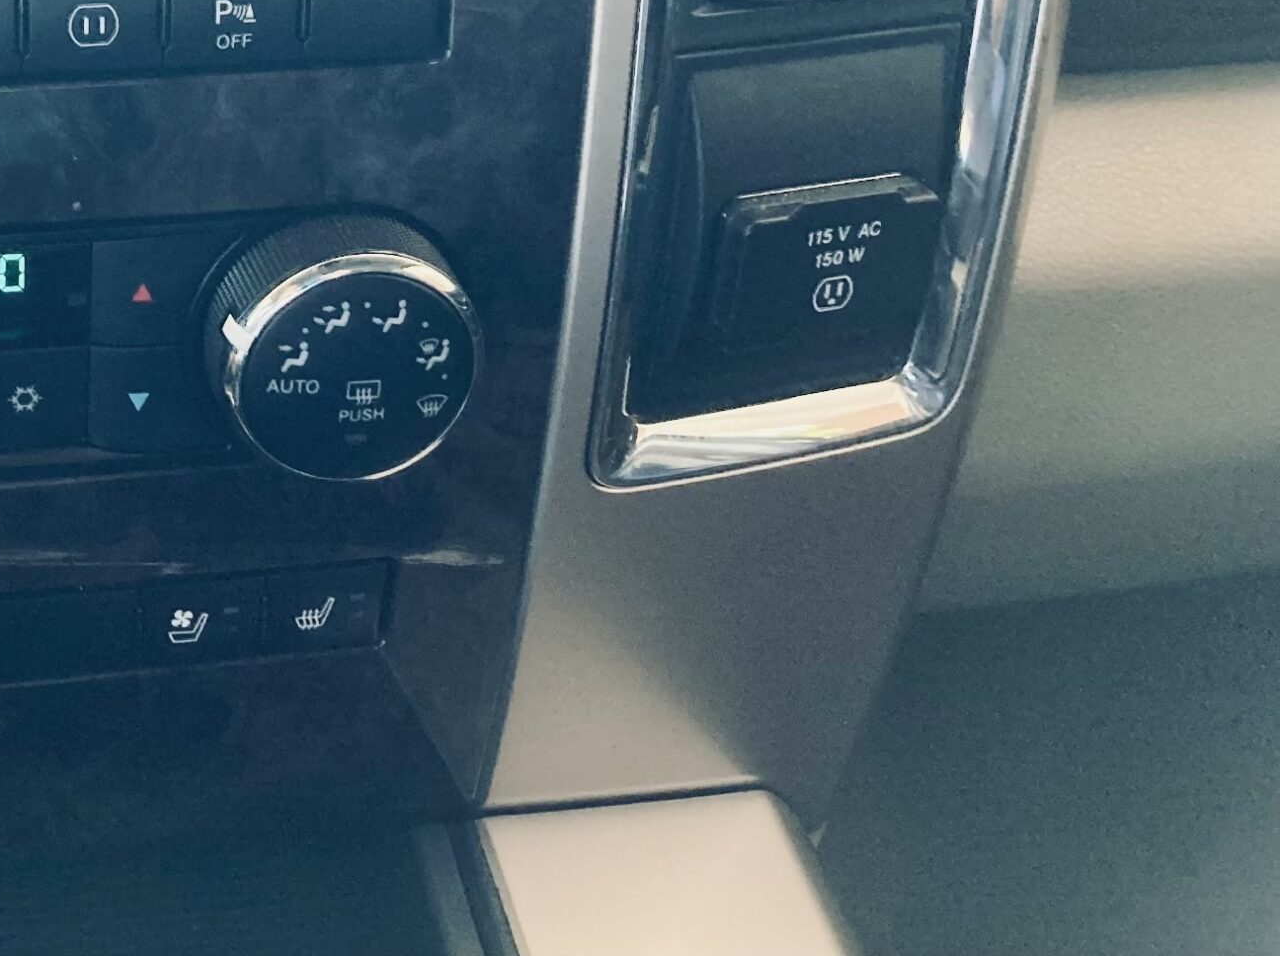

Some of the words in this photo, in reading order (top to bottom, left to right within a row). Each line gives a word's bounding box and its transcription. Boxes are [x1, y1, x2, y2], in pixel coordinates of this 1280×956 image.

[216, 33, 253, 49] OFF
[807, 227, 833, 247] 115
[838, 224, 852, 242] V
[856, 220, 883, 239] AC
[815, 250, 845, 269] 150
[849, 246, 866, 264] W
[266, 379, 321, 394] AUTO
[338, 407, 385, 422] PUSH
